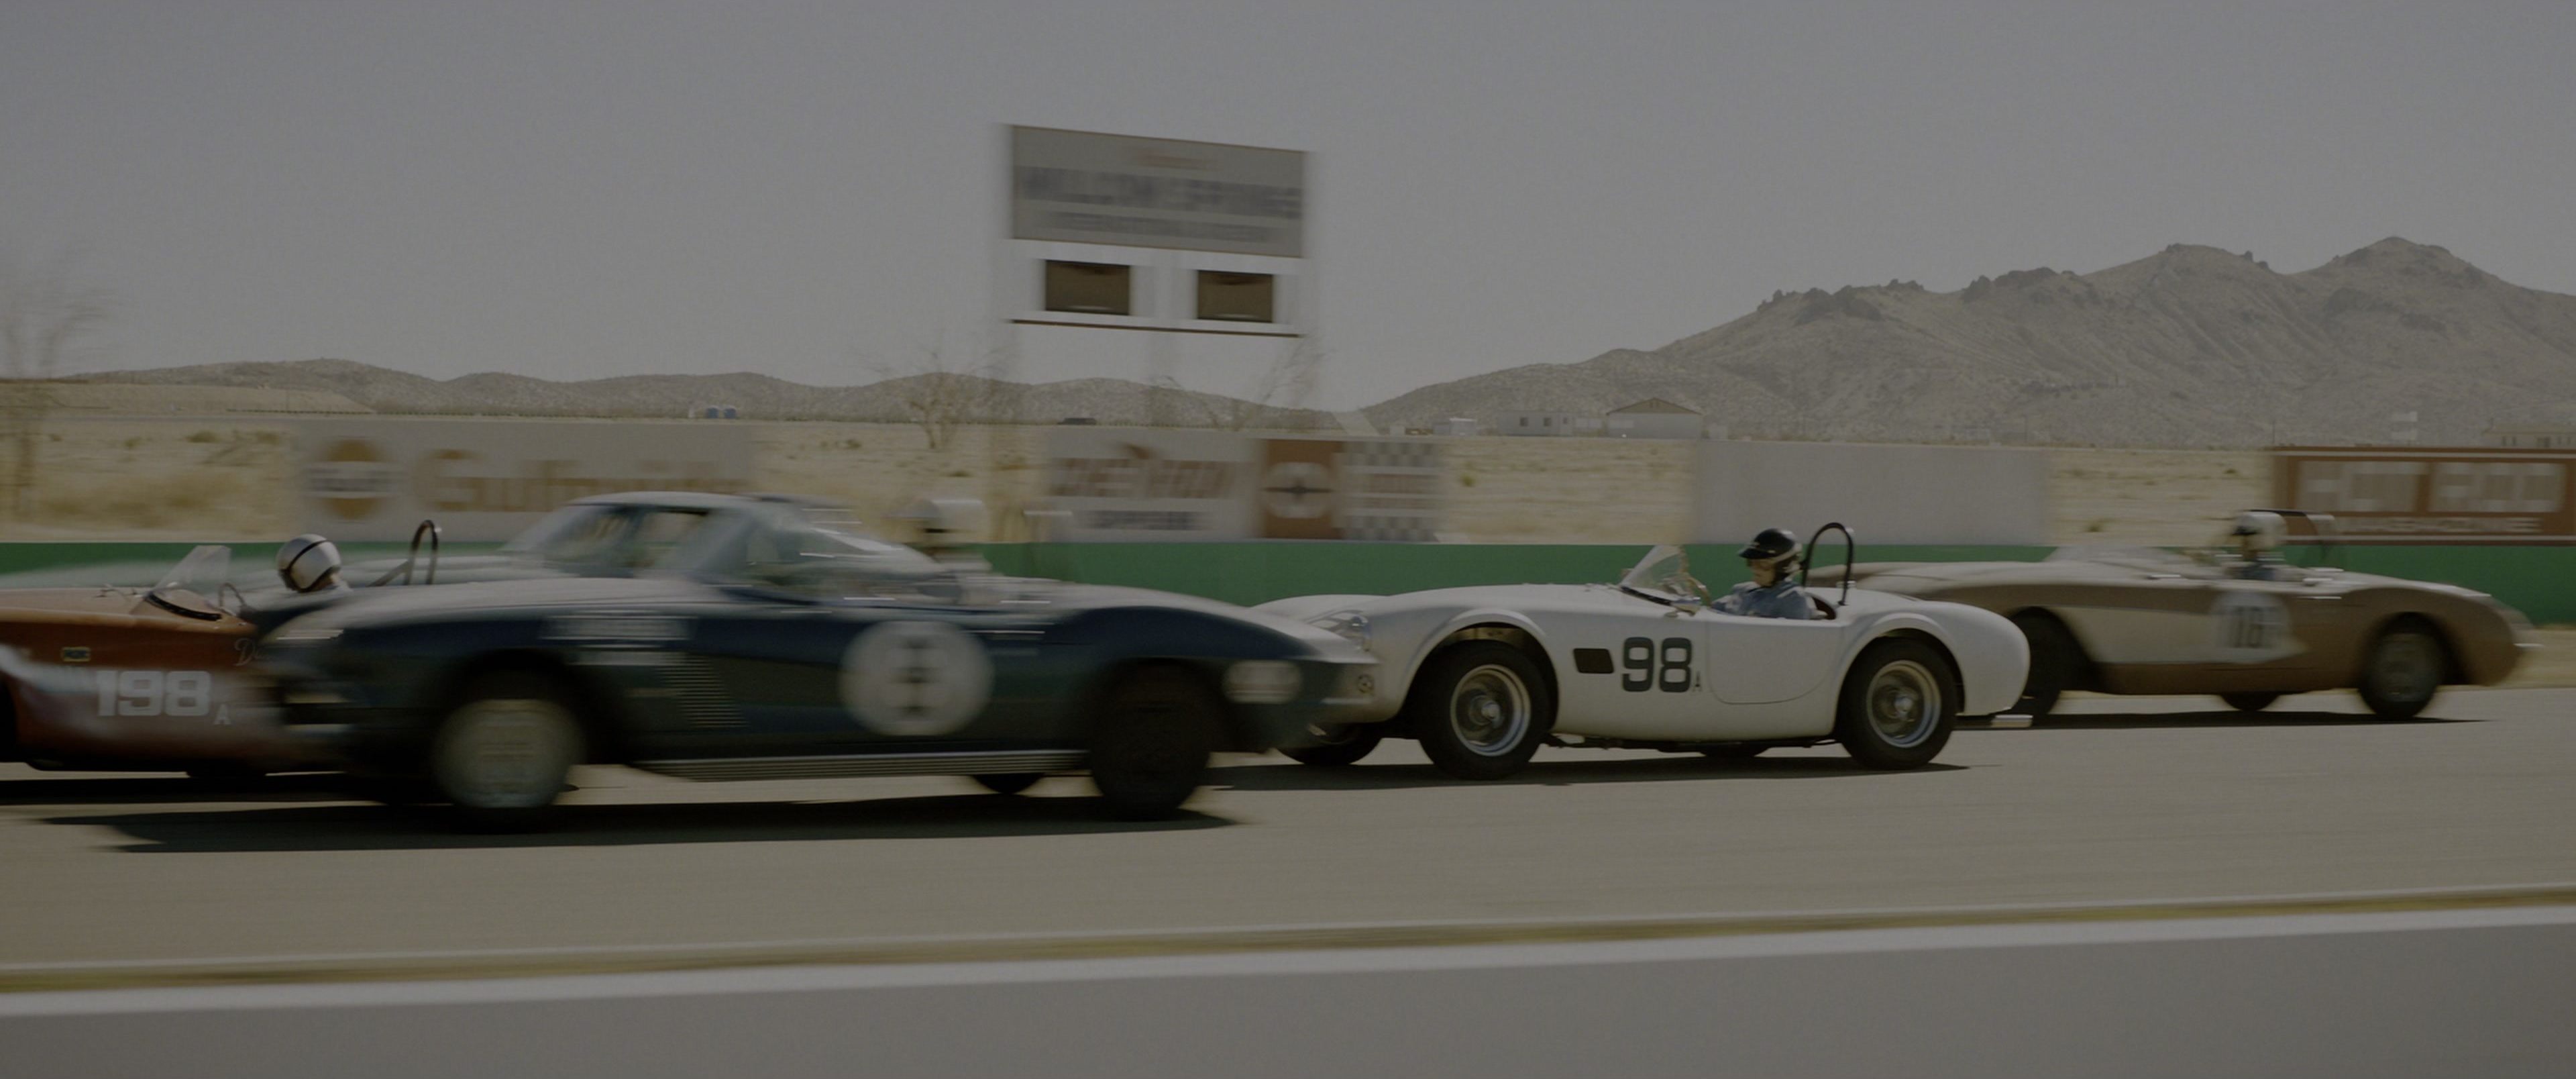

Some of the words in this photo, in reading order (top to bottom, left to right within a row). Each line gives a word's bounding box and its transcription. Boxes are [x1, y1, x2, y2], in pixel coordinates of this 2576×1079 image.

[2297, 461, 2426, 512] HOT
[2430, 463, 2565, 513] ROD
[1623, 637, 1693, 692] 98
[97, 670, 211, 717] 198
[213, 703, 231, 725] A
